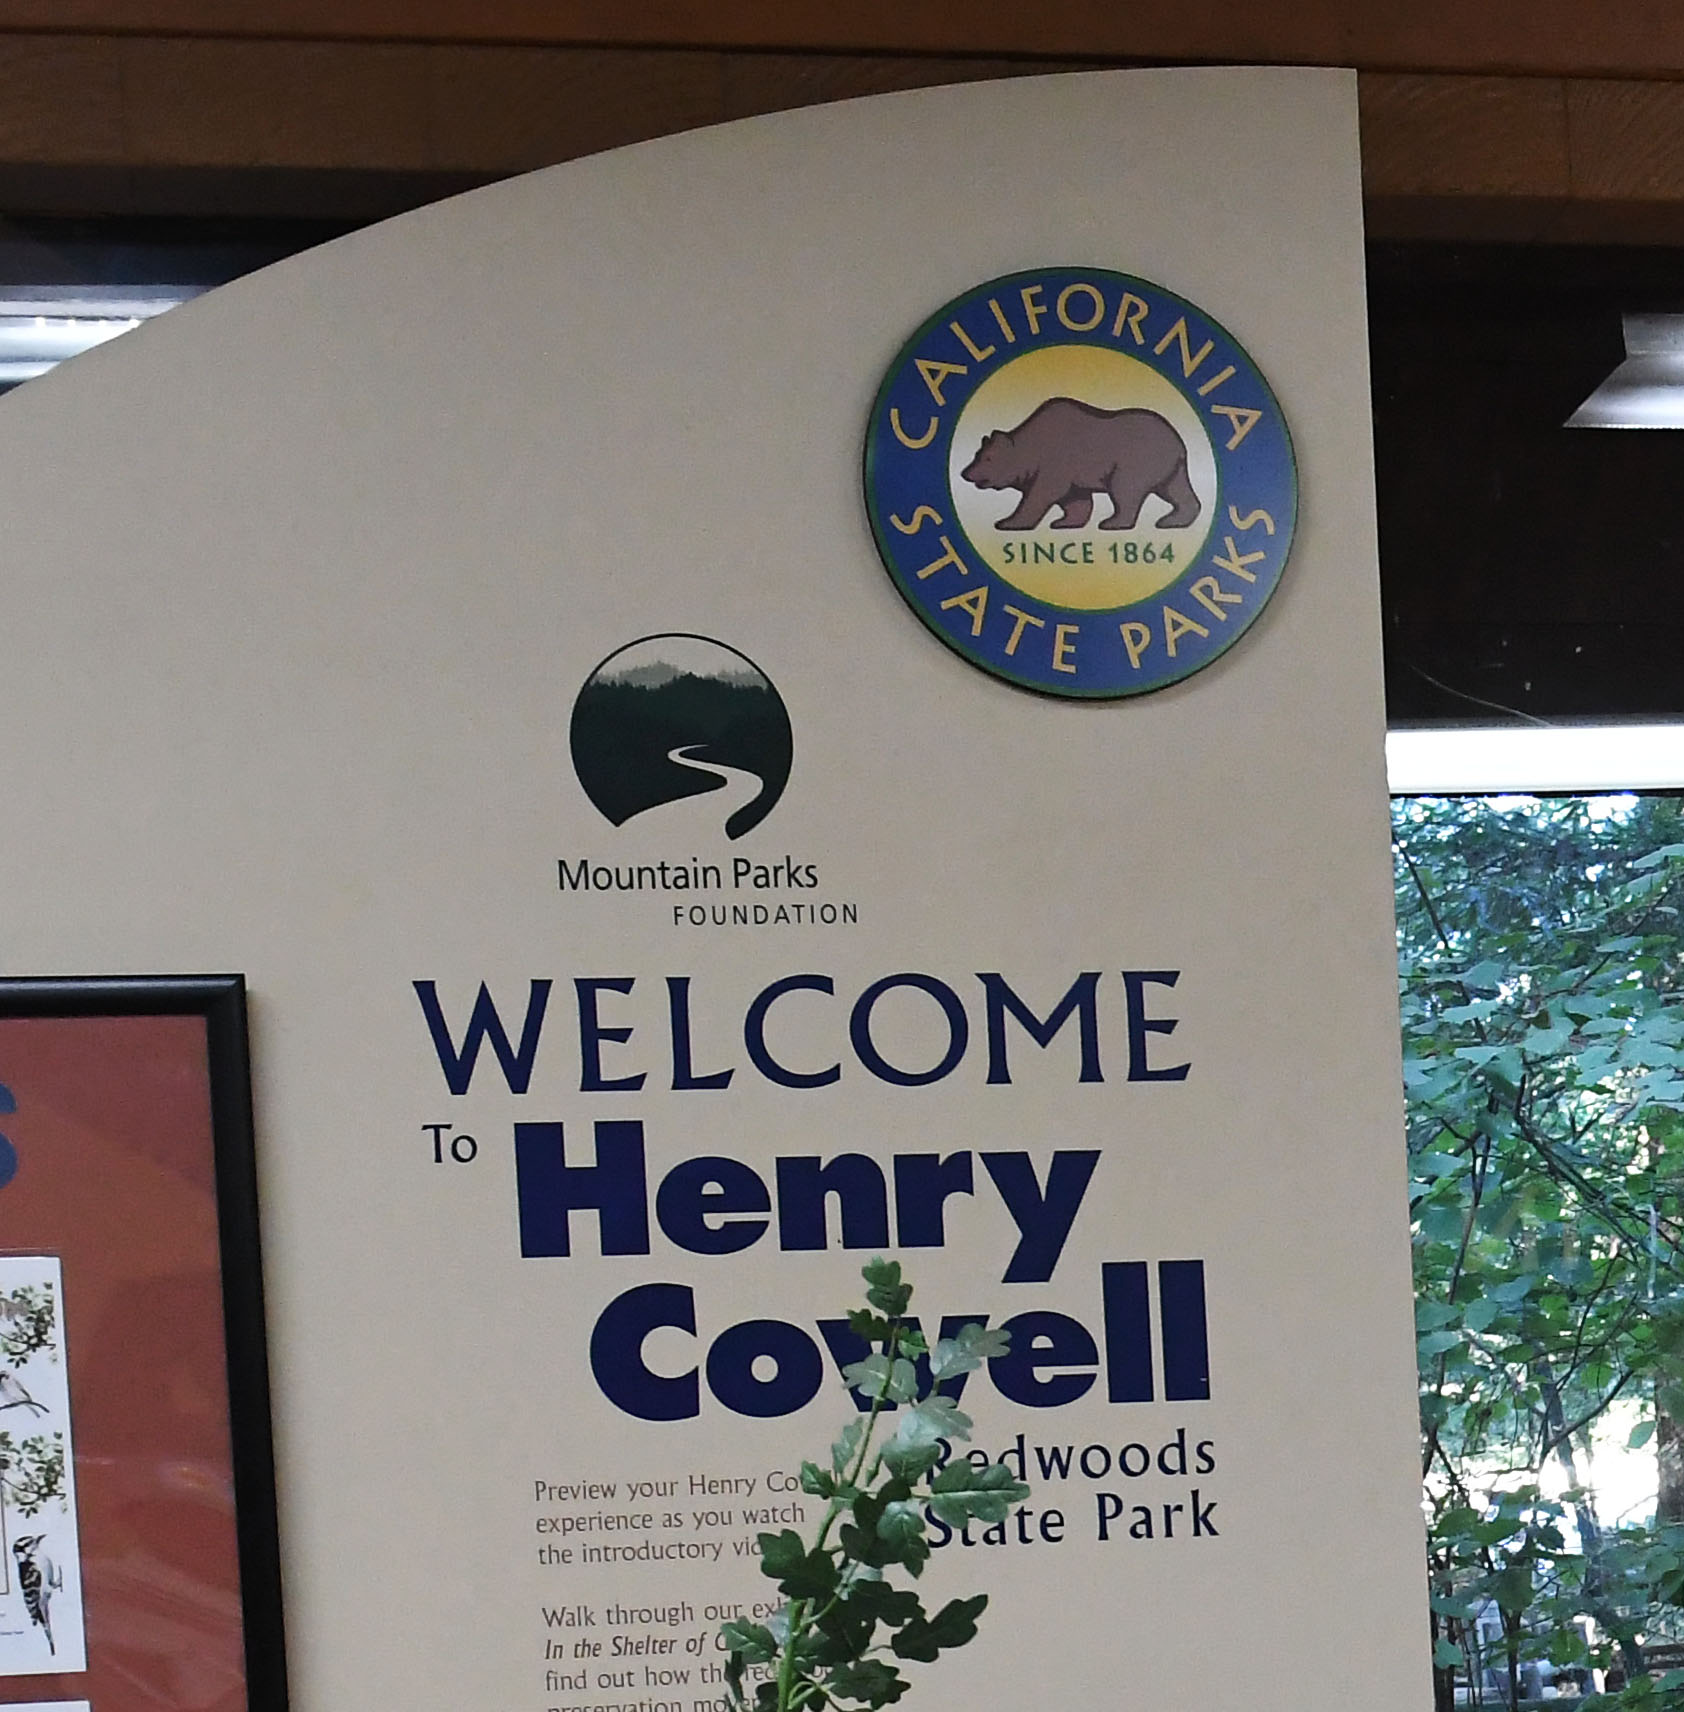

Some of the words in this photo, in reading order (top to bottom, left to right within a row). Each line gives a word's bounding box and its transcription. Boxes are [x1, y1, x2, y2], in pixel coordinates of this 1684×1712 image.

[890, 283, 1263, 451] CALIFORNIA
[1003, 541, 1095, 565] SINCE
[1108, 541, 1176, 565] 1864
[890, 505, 1080, 674] STATE
[1119, 505, 1275, 669] PARKS
[557, 857, 722, 891] Mountain
[733, 855, 819, 890] Parks
[673, 902, 859, 926] FOUNDATION
[412, 970, 1193, 1096] WELCOME
[422, 1123, 478, 1164] To
[513, 1119, 1102, 1284] Henry
[589, 1258, 1212, 1423] Cowell
[534, 1478, 617, 1502] Preview
[626, 1479, 679, 1502] your
[688, 1473, 757, 1498] Henry
[535, 1510, 653, 1537] experience
[662, 1512, 683, 1528] as
[692, 1508, 733, 1531] you
[743, 1502, 806, 1525] watch
[1096, 1488, 1220, 1542] Park
[538, 1543, 574, 1566] the
[582, 1537, 724, 1563] introductory
[541, 1604, 597, 1628] Walk
[605, 1601, 695, 1627] through
[703, 1601, 743, 1619] our
[544, 1638, 564, 1660] In
[573, 1638, 602, 1660] the
[610, 1632, 678, 1658] Shelter
[685, 1630, 709, 1656] of
[545, 1669, 588, 1691] find
[597, 1670, 637, 1690] out
[644, 1664, 691, 1686] how
